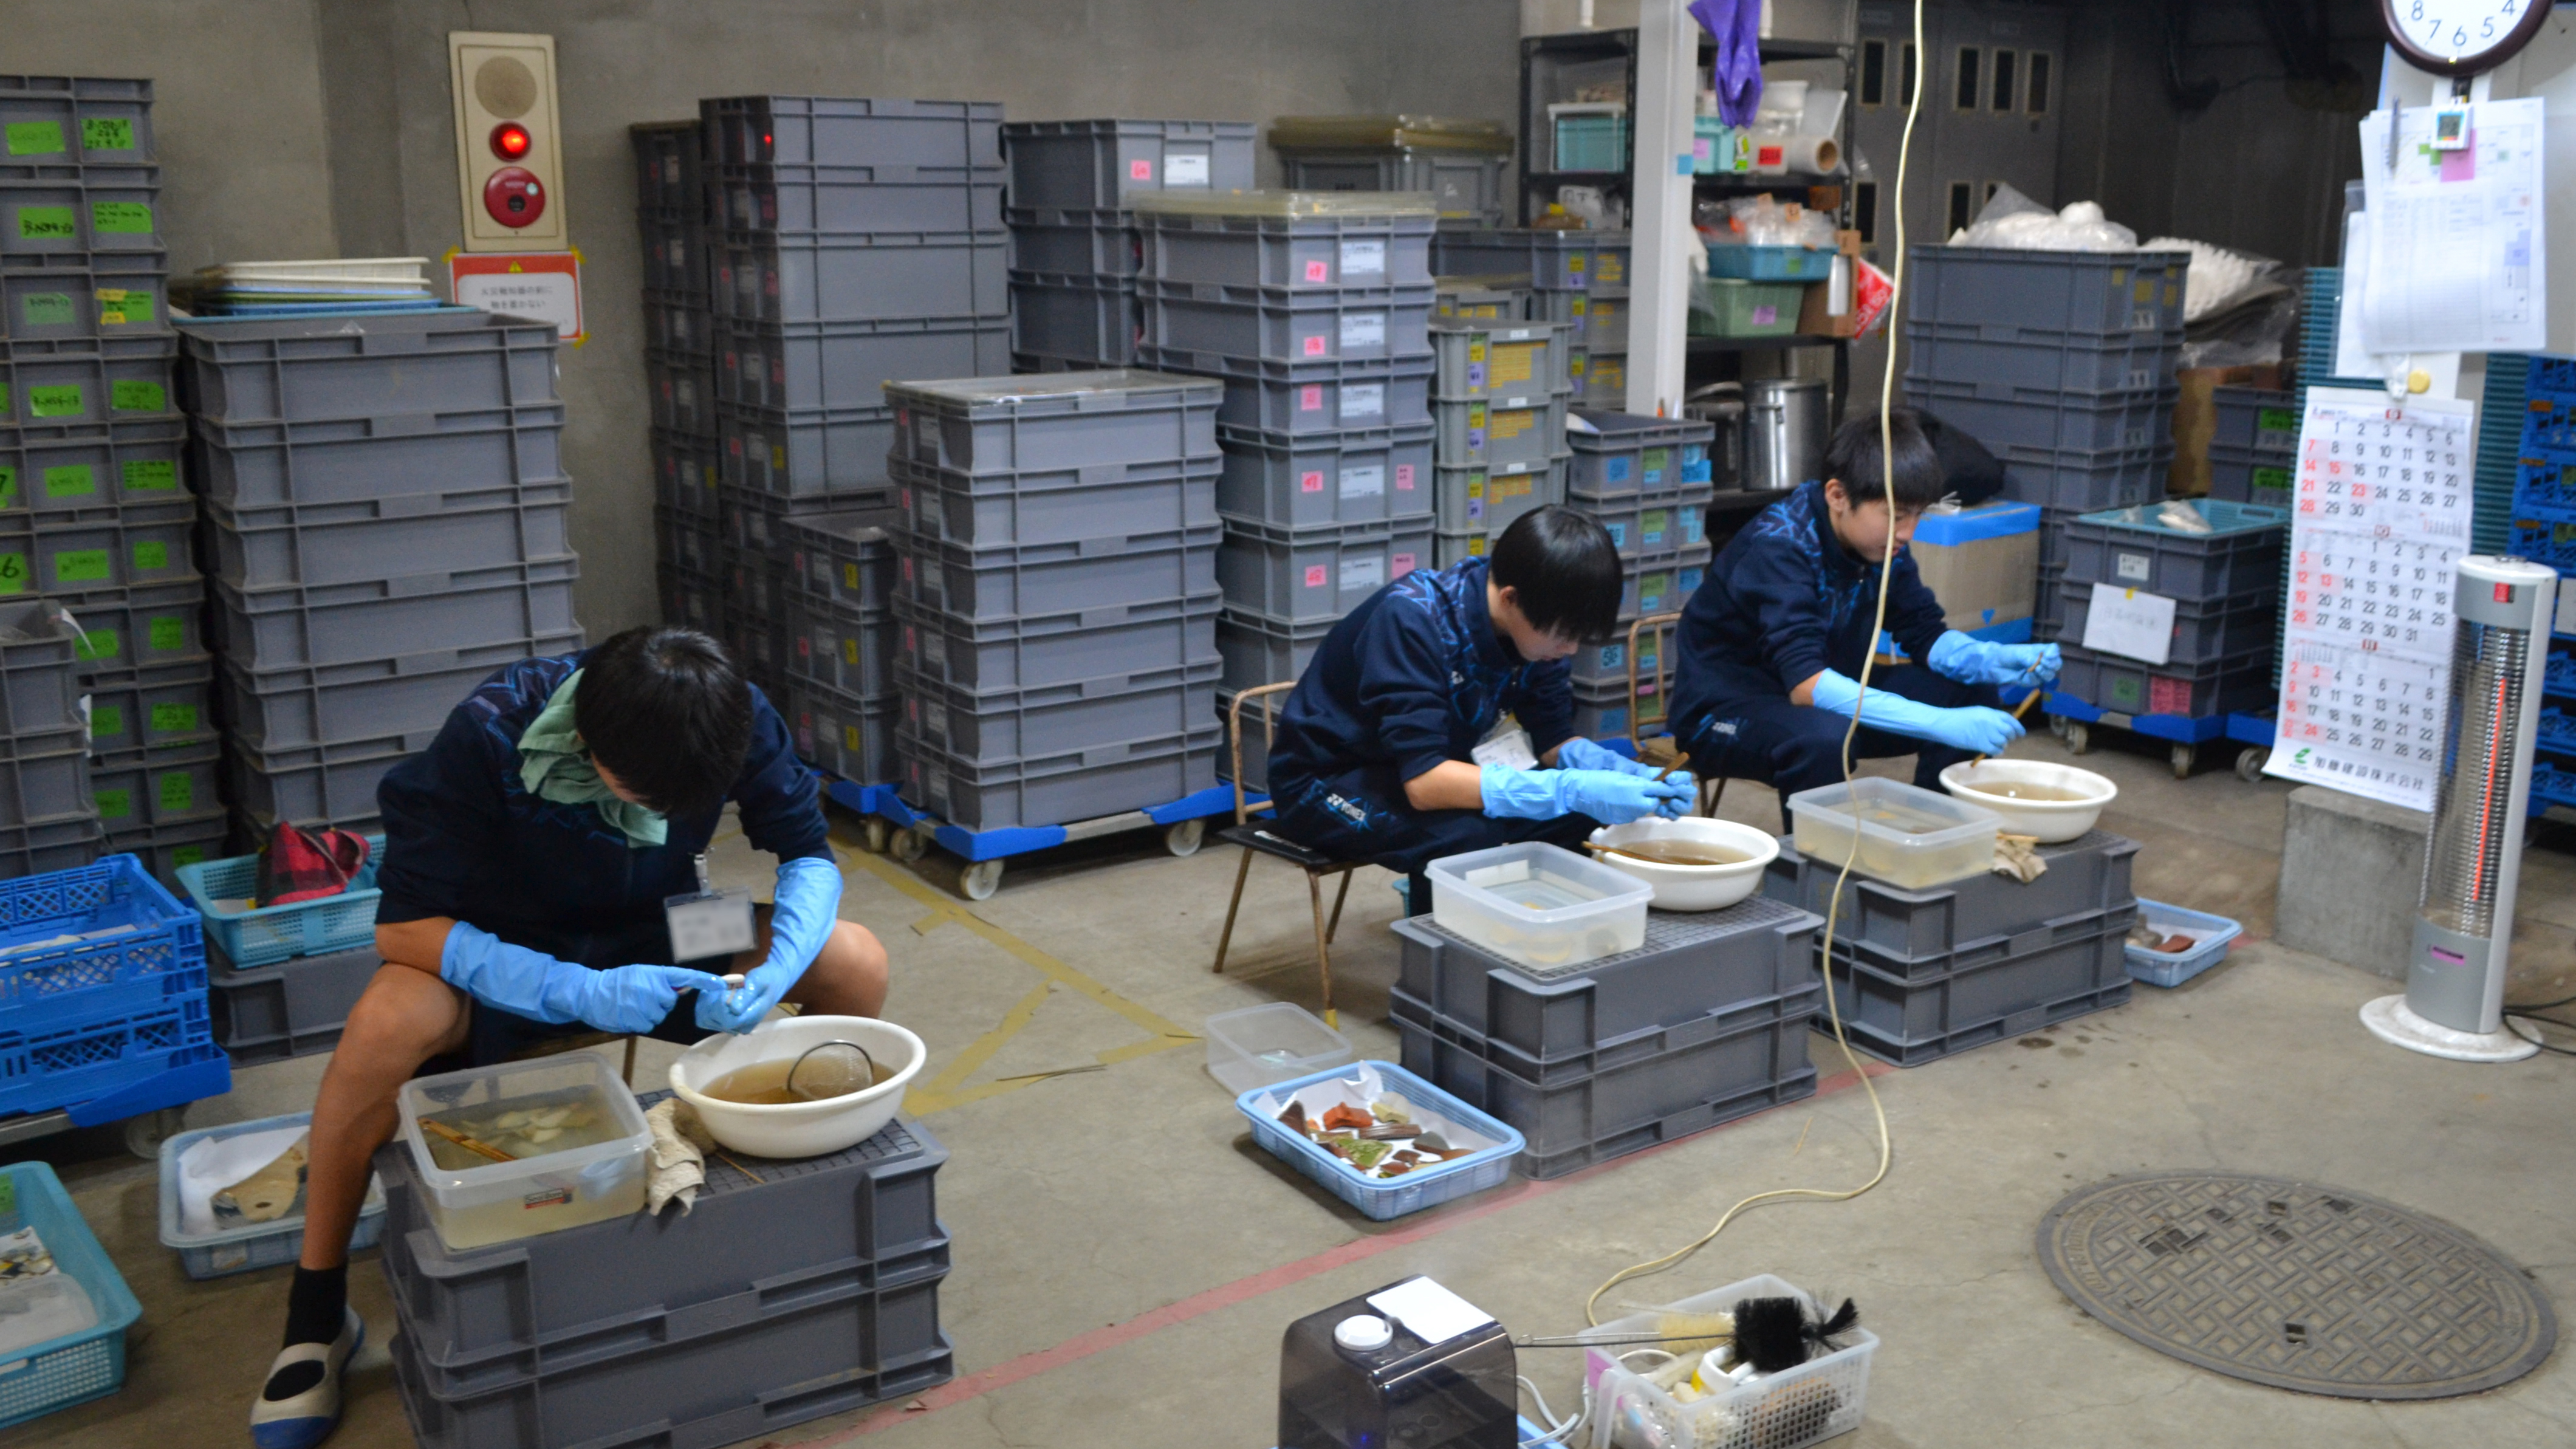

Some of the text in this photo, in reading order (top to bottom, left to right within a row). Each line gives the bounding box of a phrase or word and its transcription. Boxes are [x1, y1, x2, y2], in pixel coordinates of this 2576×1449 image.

[2411, 0, 2424, 21] 8
[2501, 0, 2516, 16] 4
[2429, 19, 2442, 39] 7
[2453, 26, 2467, 47] 6
[2480, 16, 2495, 38] 5
[2335, 421, 2452, 445] 1 2 3 4 5 6
[2308, 439, 2455, 466] 7 8 9 10 11 12 13
[2305, 459, 2458, 487] 14 15 16 17 18 19 20
[2301, 479, 2458, 507] 21 22 23 24 25 26 27
[2300, 499, 2363, 516] 28 29 30
[2373, 541, 2447, 563] 1 2 3 4
[2300, 552, 2447, 583] 5 6 7 8 9 10 11
[2297, 570, 2446, 605] 12 13 14 15 16 17 18
[2296, 591, 2445, 626] 19 20 21 22 23 24 25
[2293, 609, 2417, 642] 26 27 28 29 30 31
[2291, 661, 2433, 700] 2 3 4 5 6 7 8
[2429, 667, 2434, 679] 1
[2289, 680, 2433, 721] 9 10 11 12 13 14 15
[2286, 700, 2433, 741] 16 17 18 19 20 21 22
[2304, 724, 2317, 736] 24
[2326, 728, 2339, 741] 25
[2349, 733, 2362, 746] 26
[2371, 738, 2385, 750] 27
[2395, 742, 2408, 756] 28
[2419, 748, 2432, 761] 29
